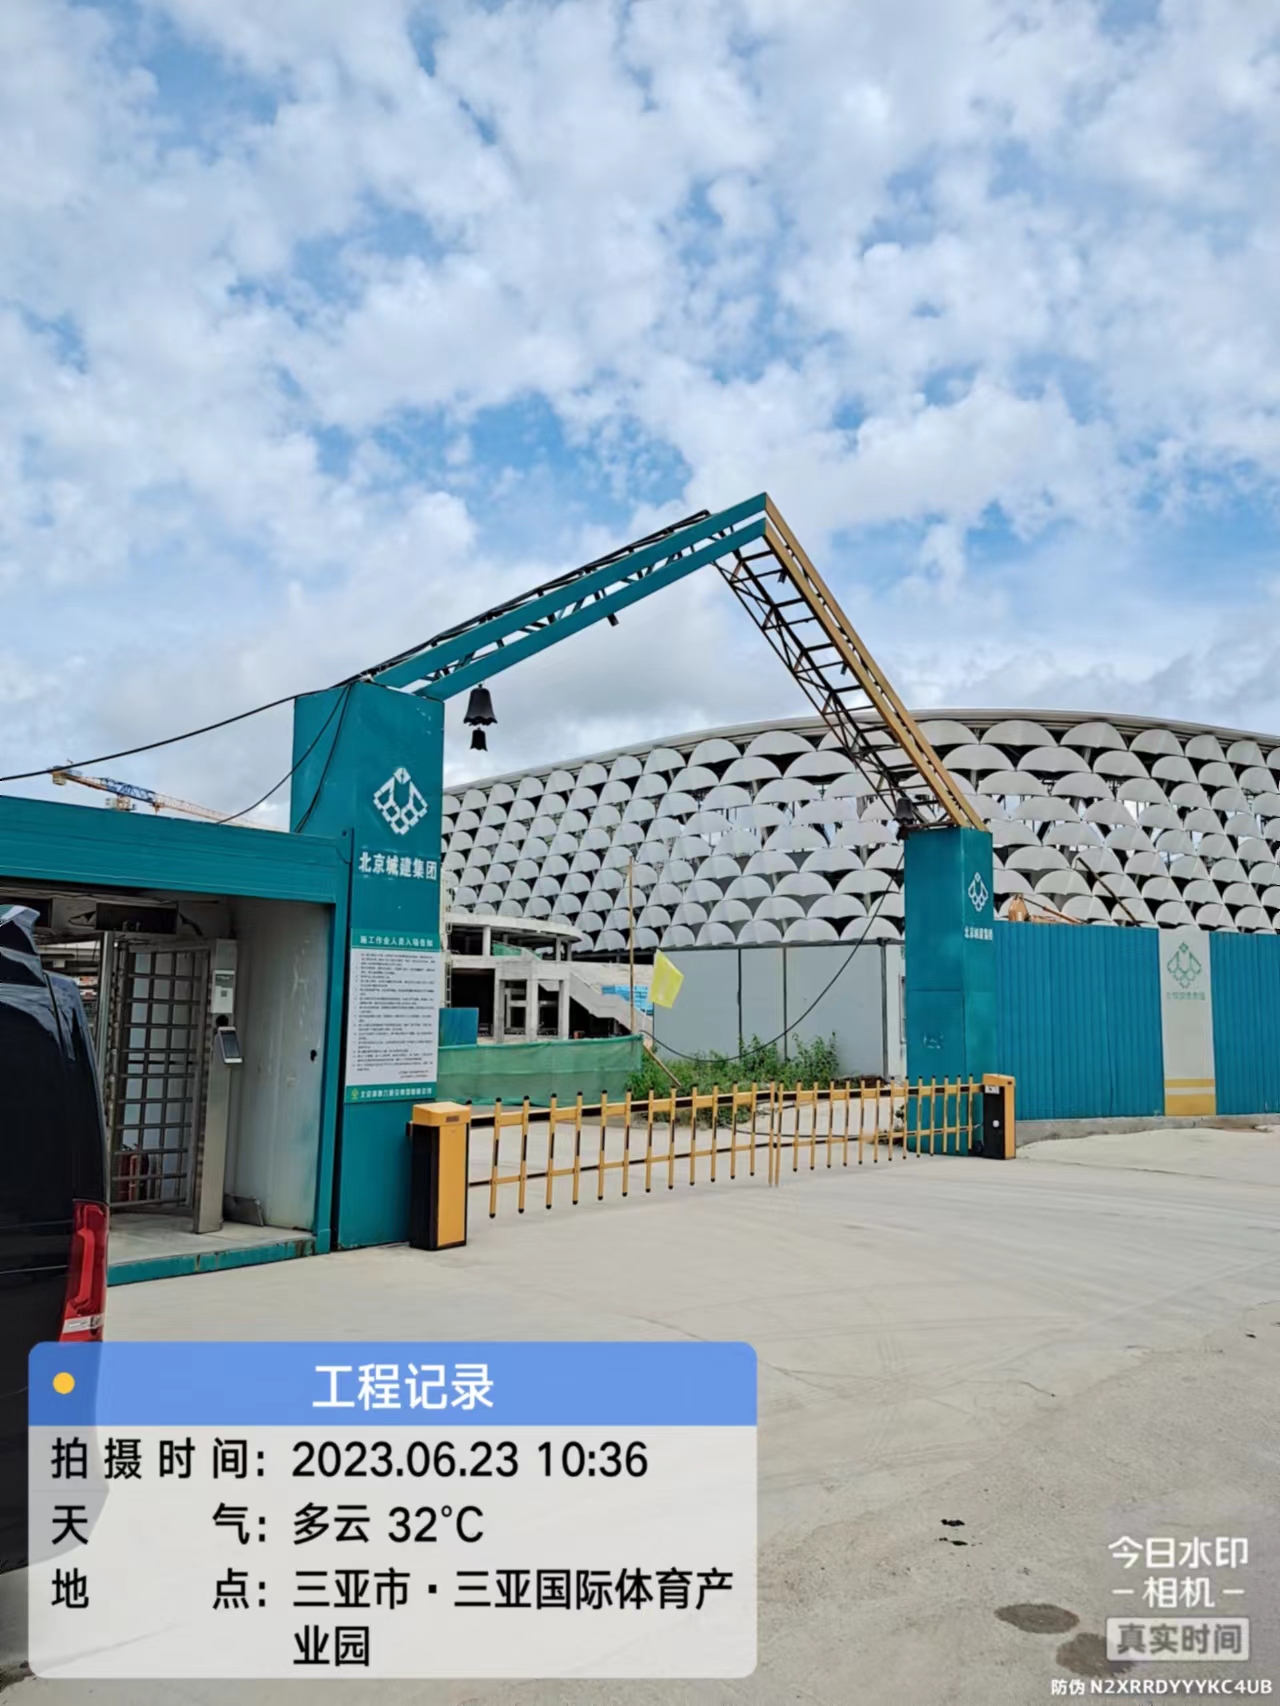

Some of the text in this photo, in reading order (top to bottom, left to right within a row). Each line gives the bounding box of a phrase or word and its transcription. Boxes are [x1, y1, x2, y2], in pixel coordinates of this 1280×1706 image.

[359, 851, 437, 881] 北京城建集团
